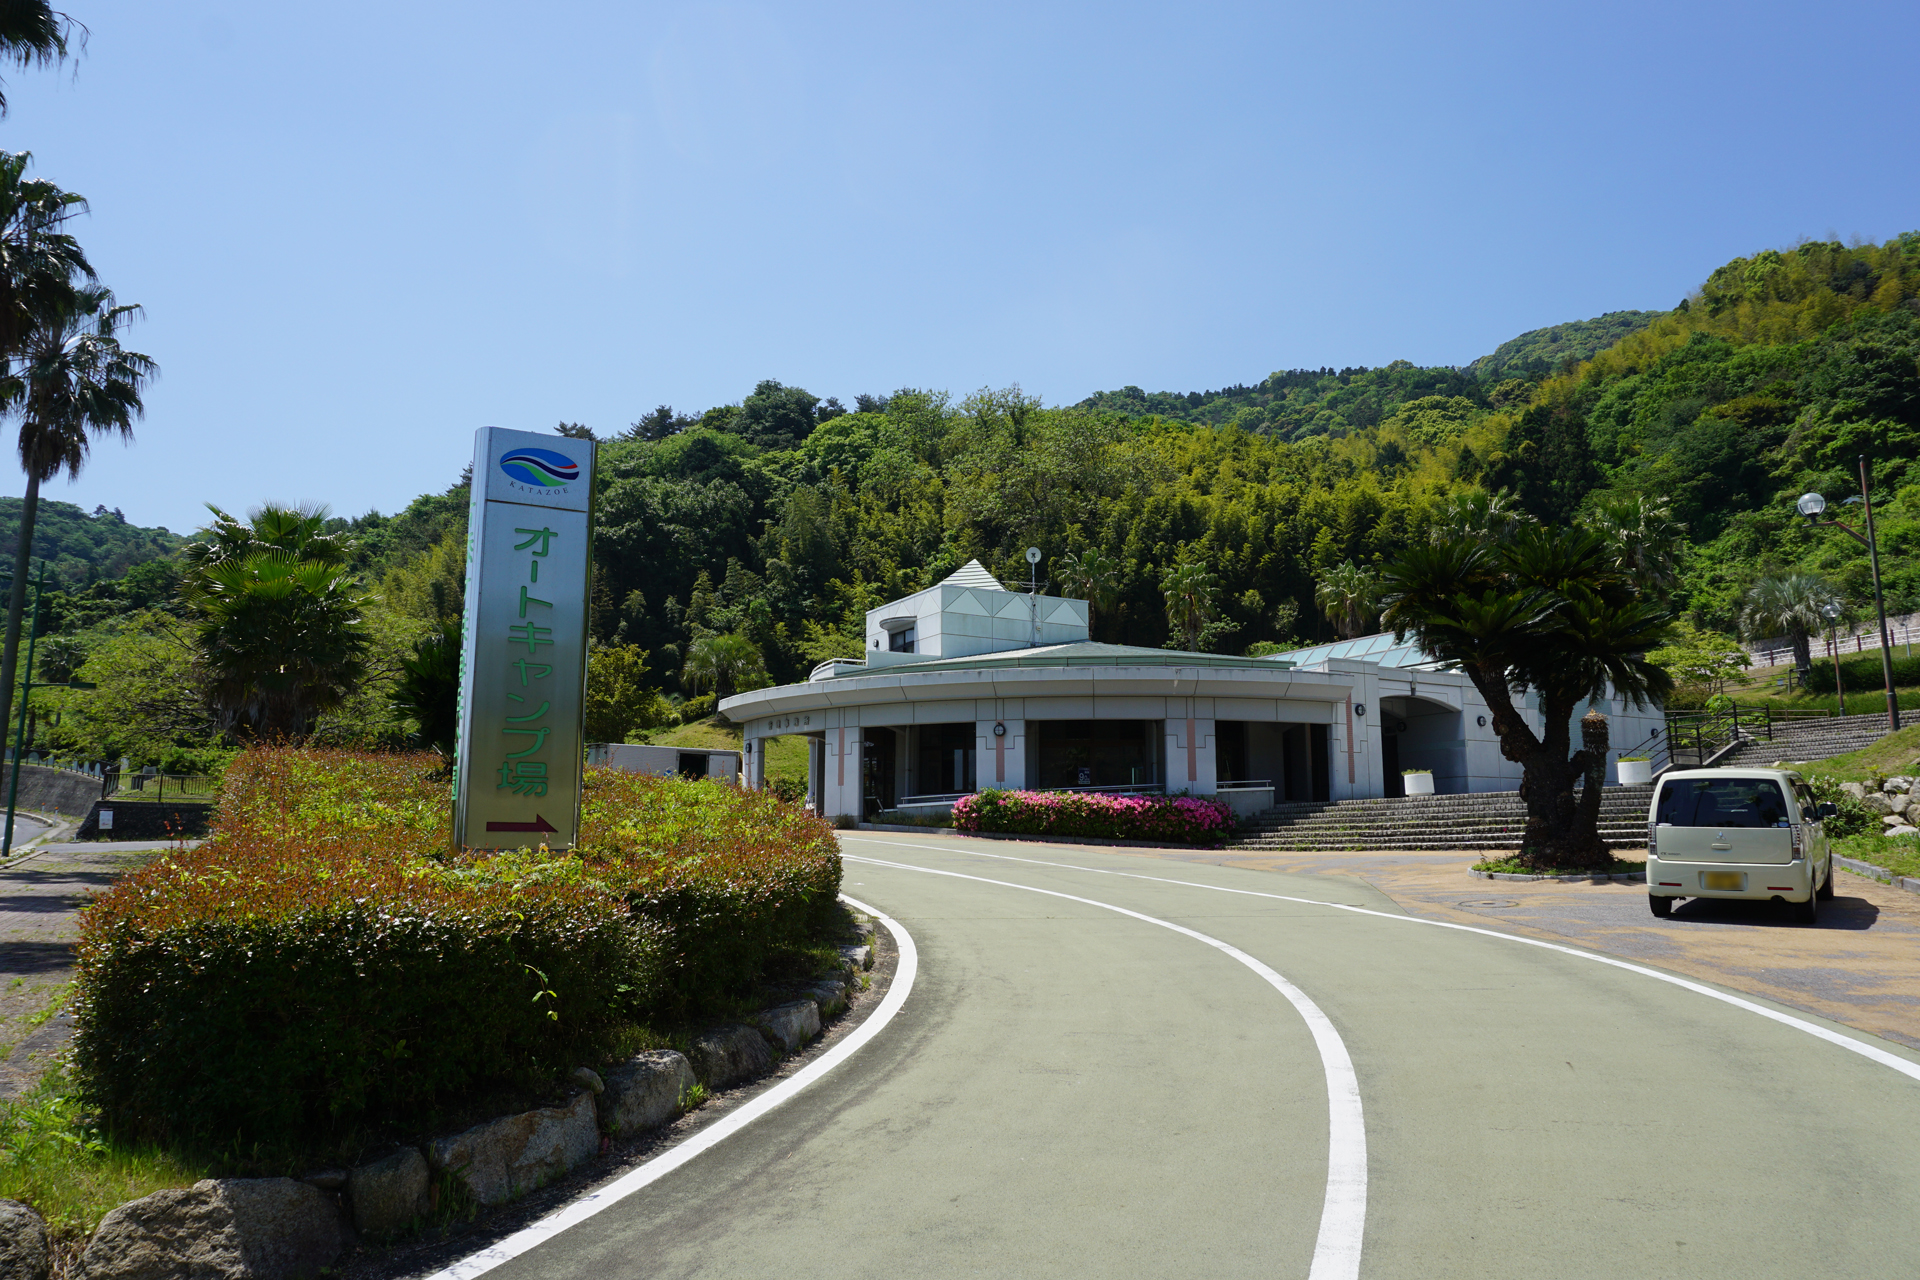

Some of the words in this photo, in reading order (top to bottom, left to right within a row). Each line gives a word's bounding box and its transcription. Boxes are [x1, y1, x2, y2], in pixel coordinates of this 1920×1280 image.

[509, 480, 569, 496] KATAZOE
[497, 527, 559, 797] オートキャンプ場
